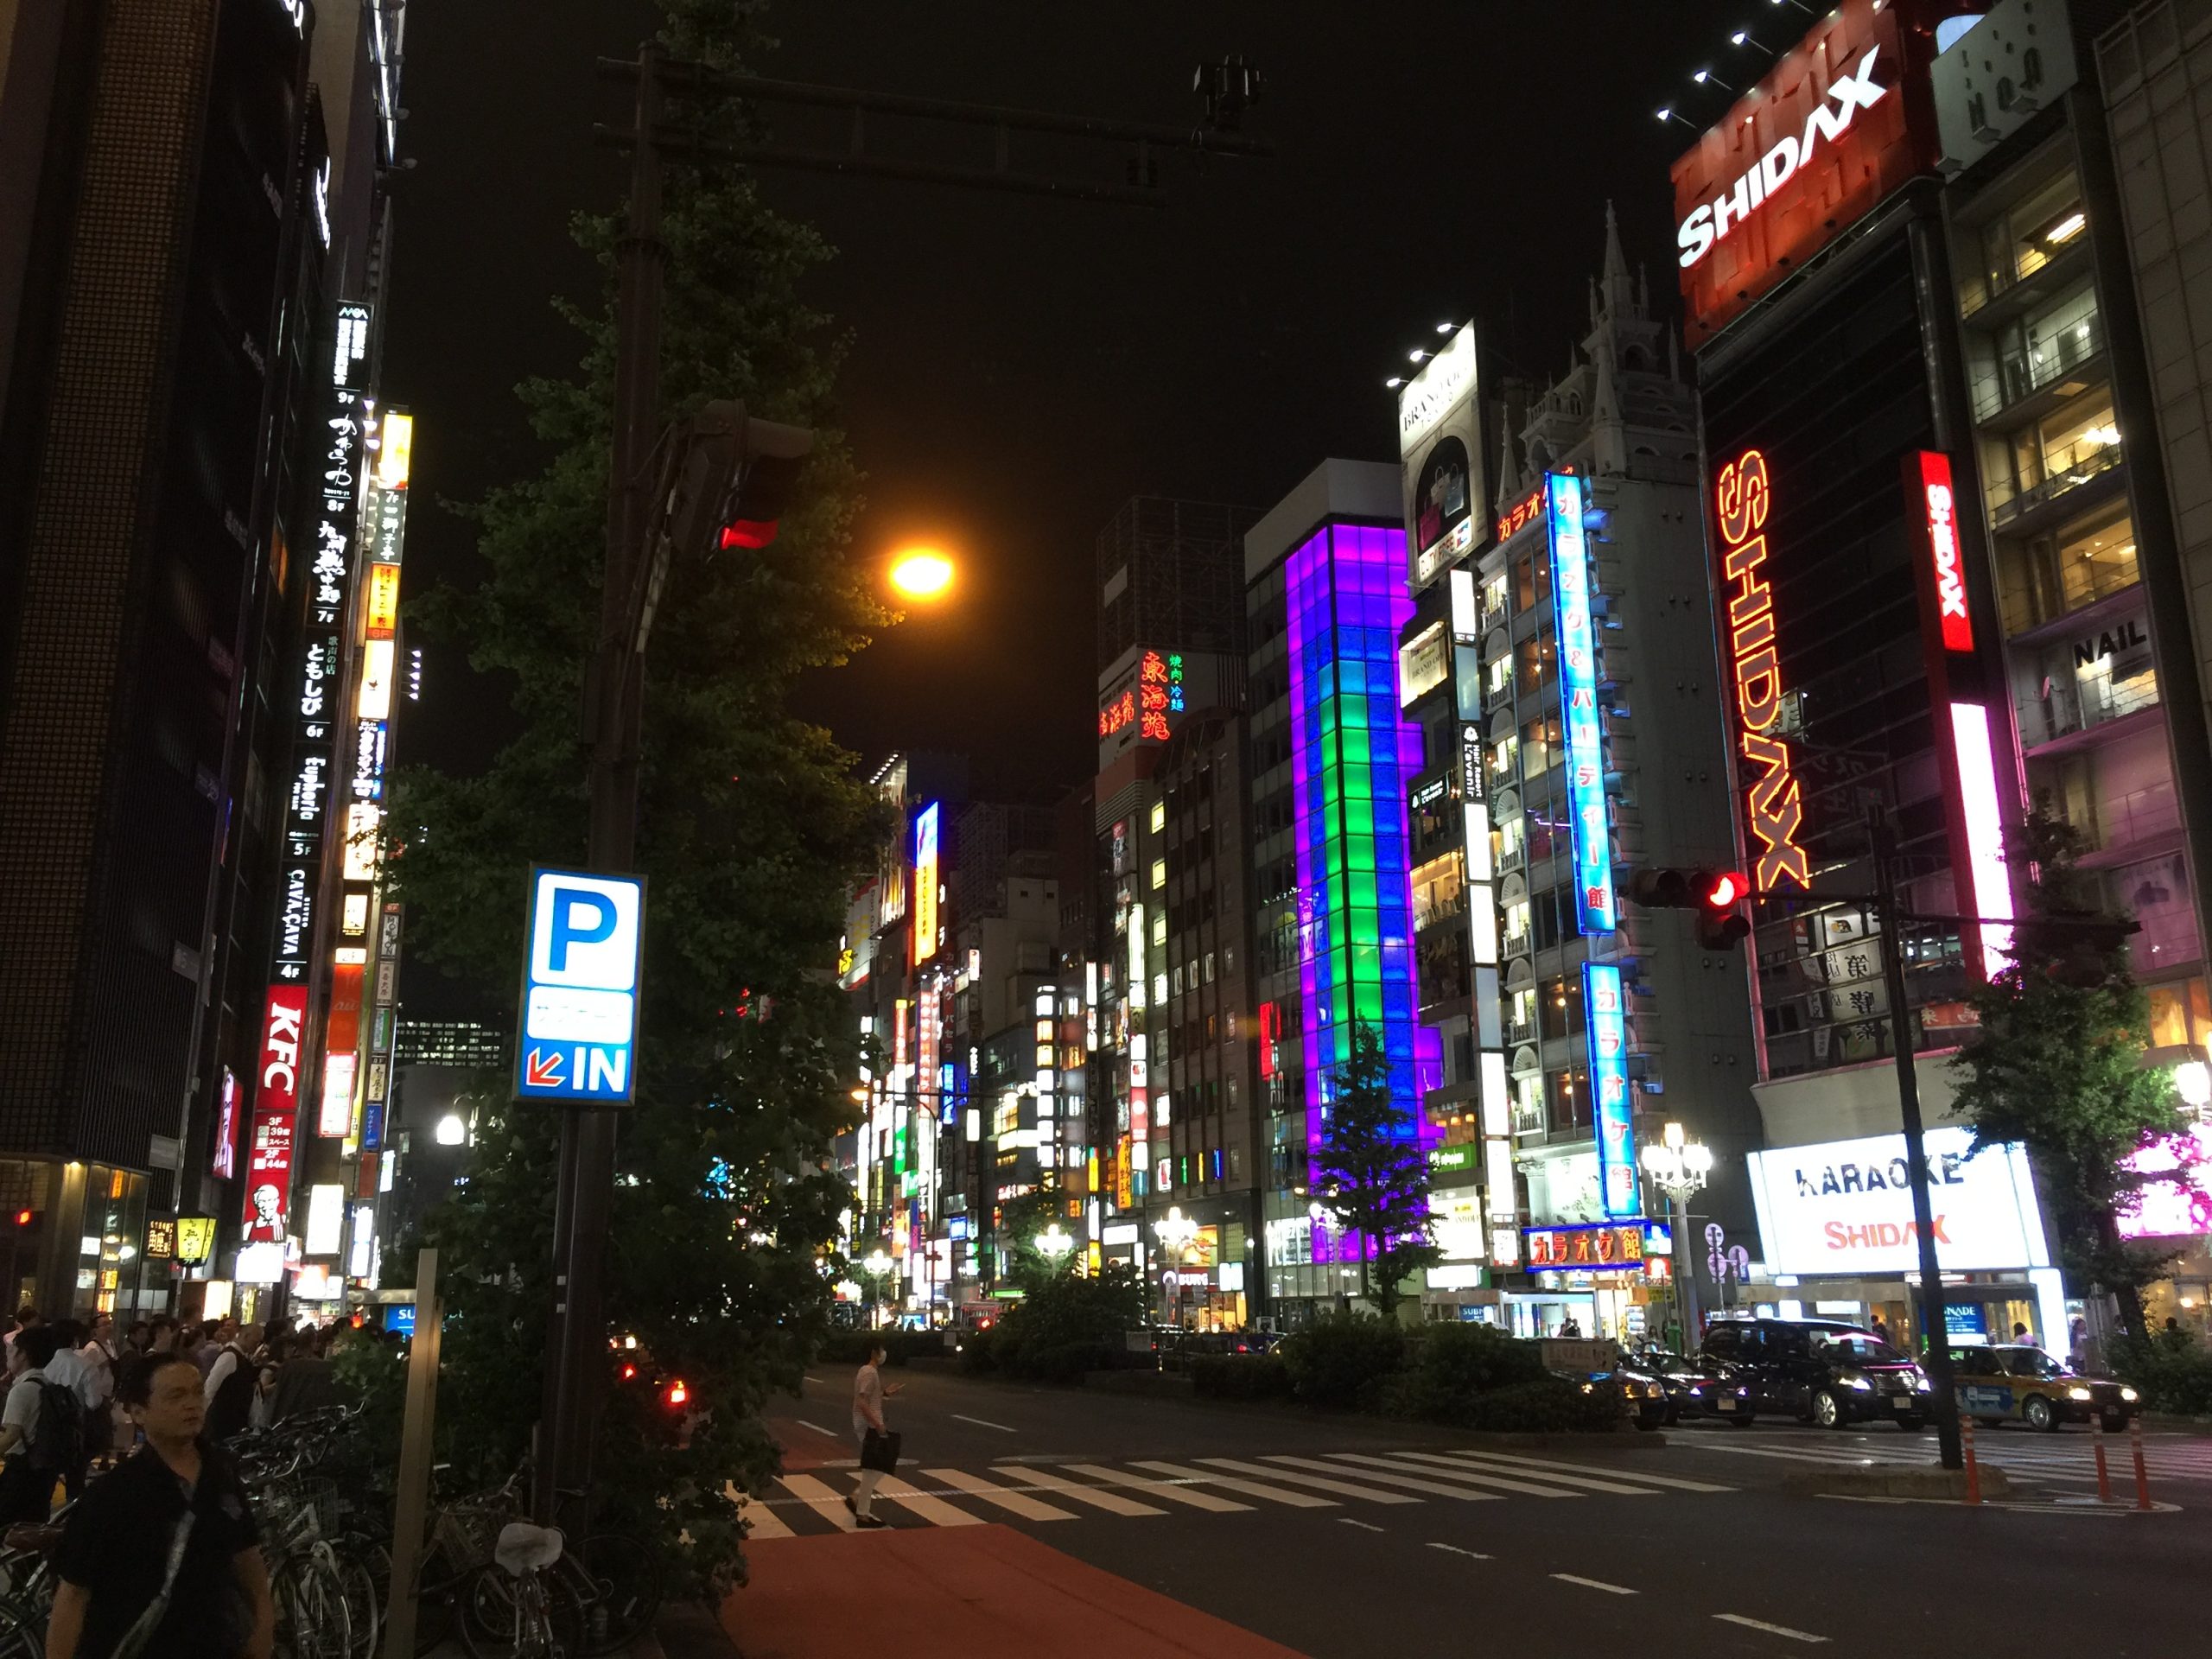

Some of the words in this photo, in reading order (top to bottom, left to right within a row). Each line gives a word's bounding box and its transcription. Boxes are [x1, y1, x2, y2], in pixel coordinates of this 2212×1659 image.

[1677, 43, 1887, 268] SHIDAX
[327, 499, 345, 512] 8F
[1927, 485, 1966, 620] SHIDAX
[318, 610, 334, 623] 7F
[2074, 620, 2146, 670] NAIL
[301, 644, 325, 716] ともしび
[1718, 449, 1810, 904] SHIDAX
[306, 725, 323, 738] 6F
[299, 757, 326, 820] Euphoria
[294, 843, 311, 855] 5F
[549, 887, 618, 972] P
[281, 964, 300, 978] 4F
[264, 1002, 303, 1096] KFC
[572, 1046, 627, 1093] IN
[1598, 988, 1634, 1192] カラオケ館
[269, 1117, 283, 1126] 3F
[264, 1150, 279, 1159] 2F
[1533, 1230, 1641, 1265] カラオケ館
[1824, 1215, 1952, 1250] SHIDAX
